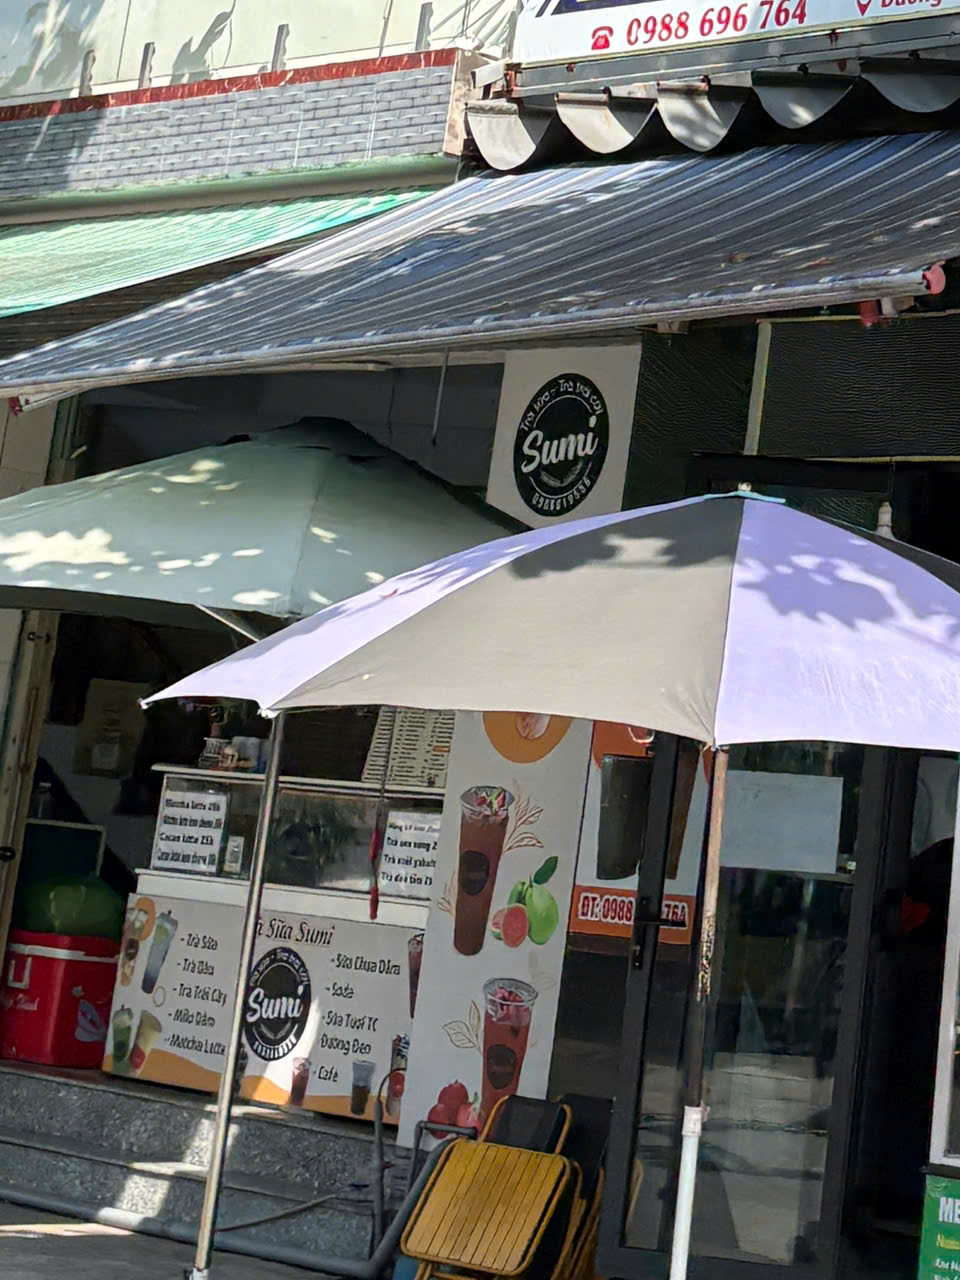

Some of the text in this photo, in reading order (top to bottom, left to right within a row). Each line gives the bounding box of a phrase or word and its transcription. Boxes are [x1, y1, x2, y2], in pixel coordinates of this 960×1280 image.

[626, 11, 690, 46] 0988
[700, 3, 748, 37] 696
[520, 415, 599, 474] Sumi
[602, 897, 633, 922] 0988
[245, 984, 303, 1023] Sumi
